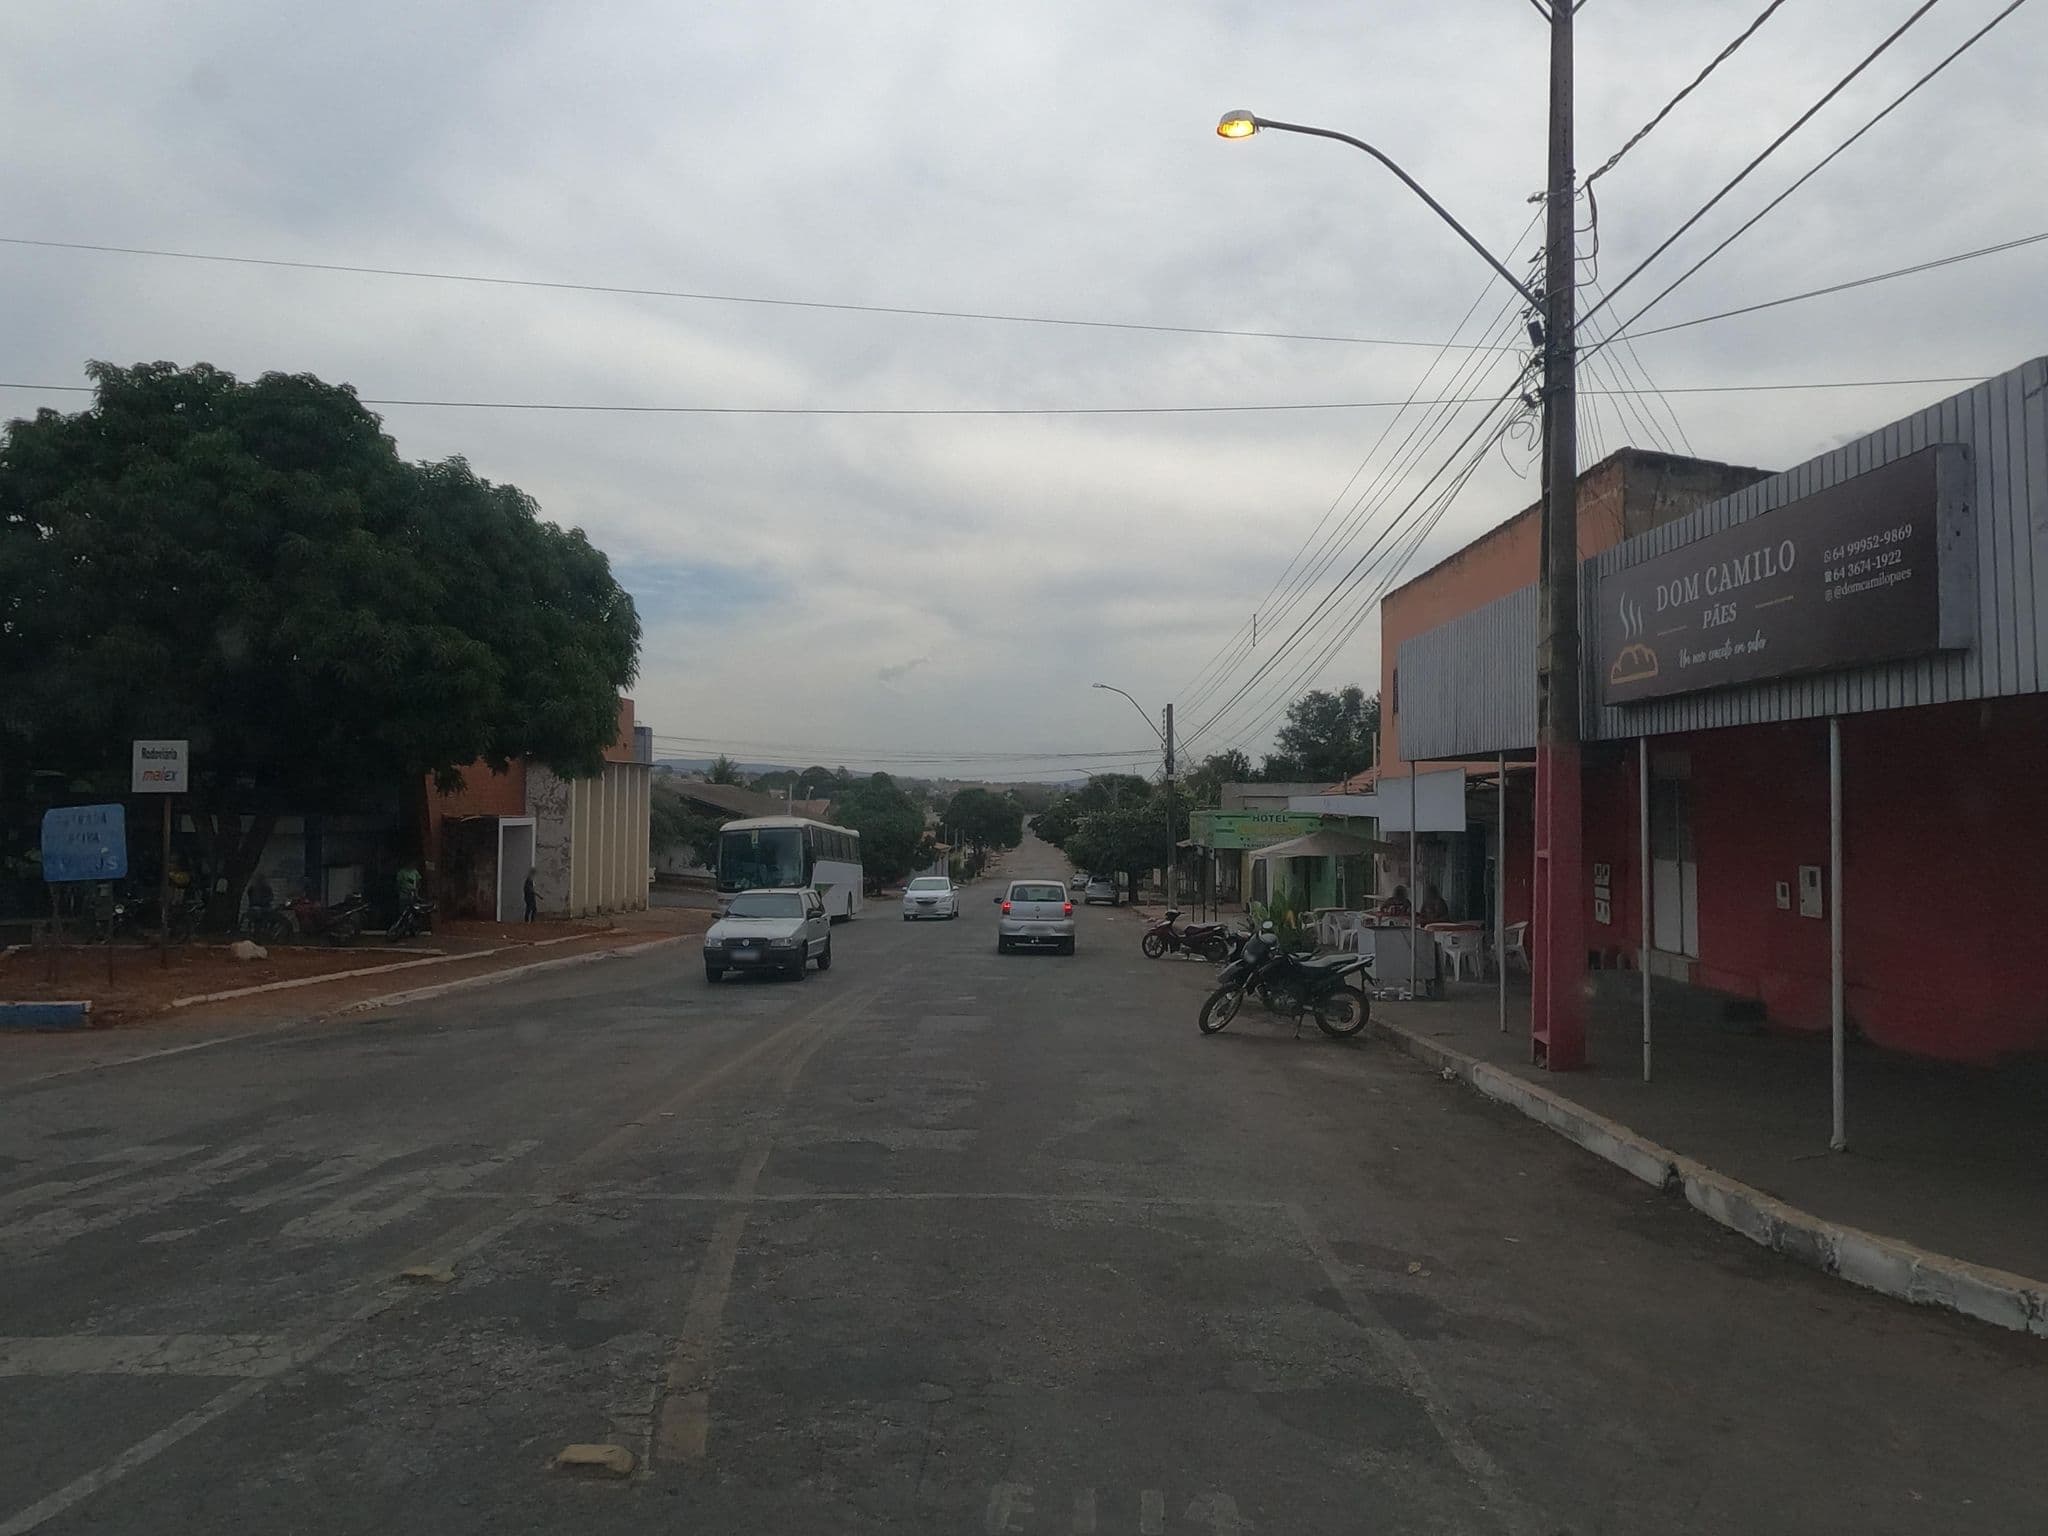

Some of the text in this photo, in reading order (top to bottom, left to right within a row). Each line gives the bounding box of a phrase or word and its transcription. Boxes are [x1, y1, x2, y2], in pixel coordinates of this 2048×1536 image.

[1833, 545, 1845, 561] 64
[1656, 540, 1796, 612] DOM CAMILO
[1833, 567, 1845, 581] 64
[1702, 602, 1737, 630] PÃES
[1252, 814, 1289, 823] HOTEL
